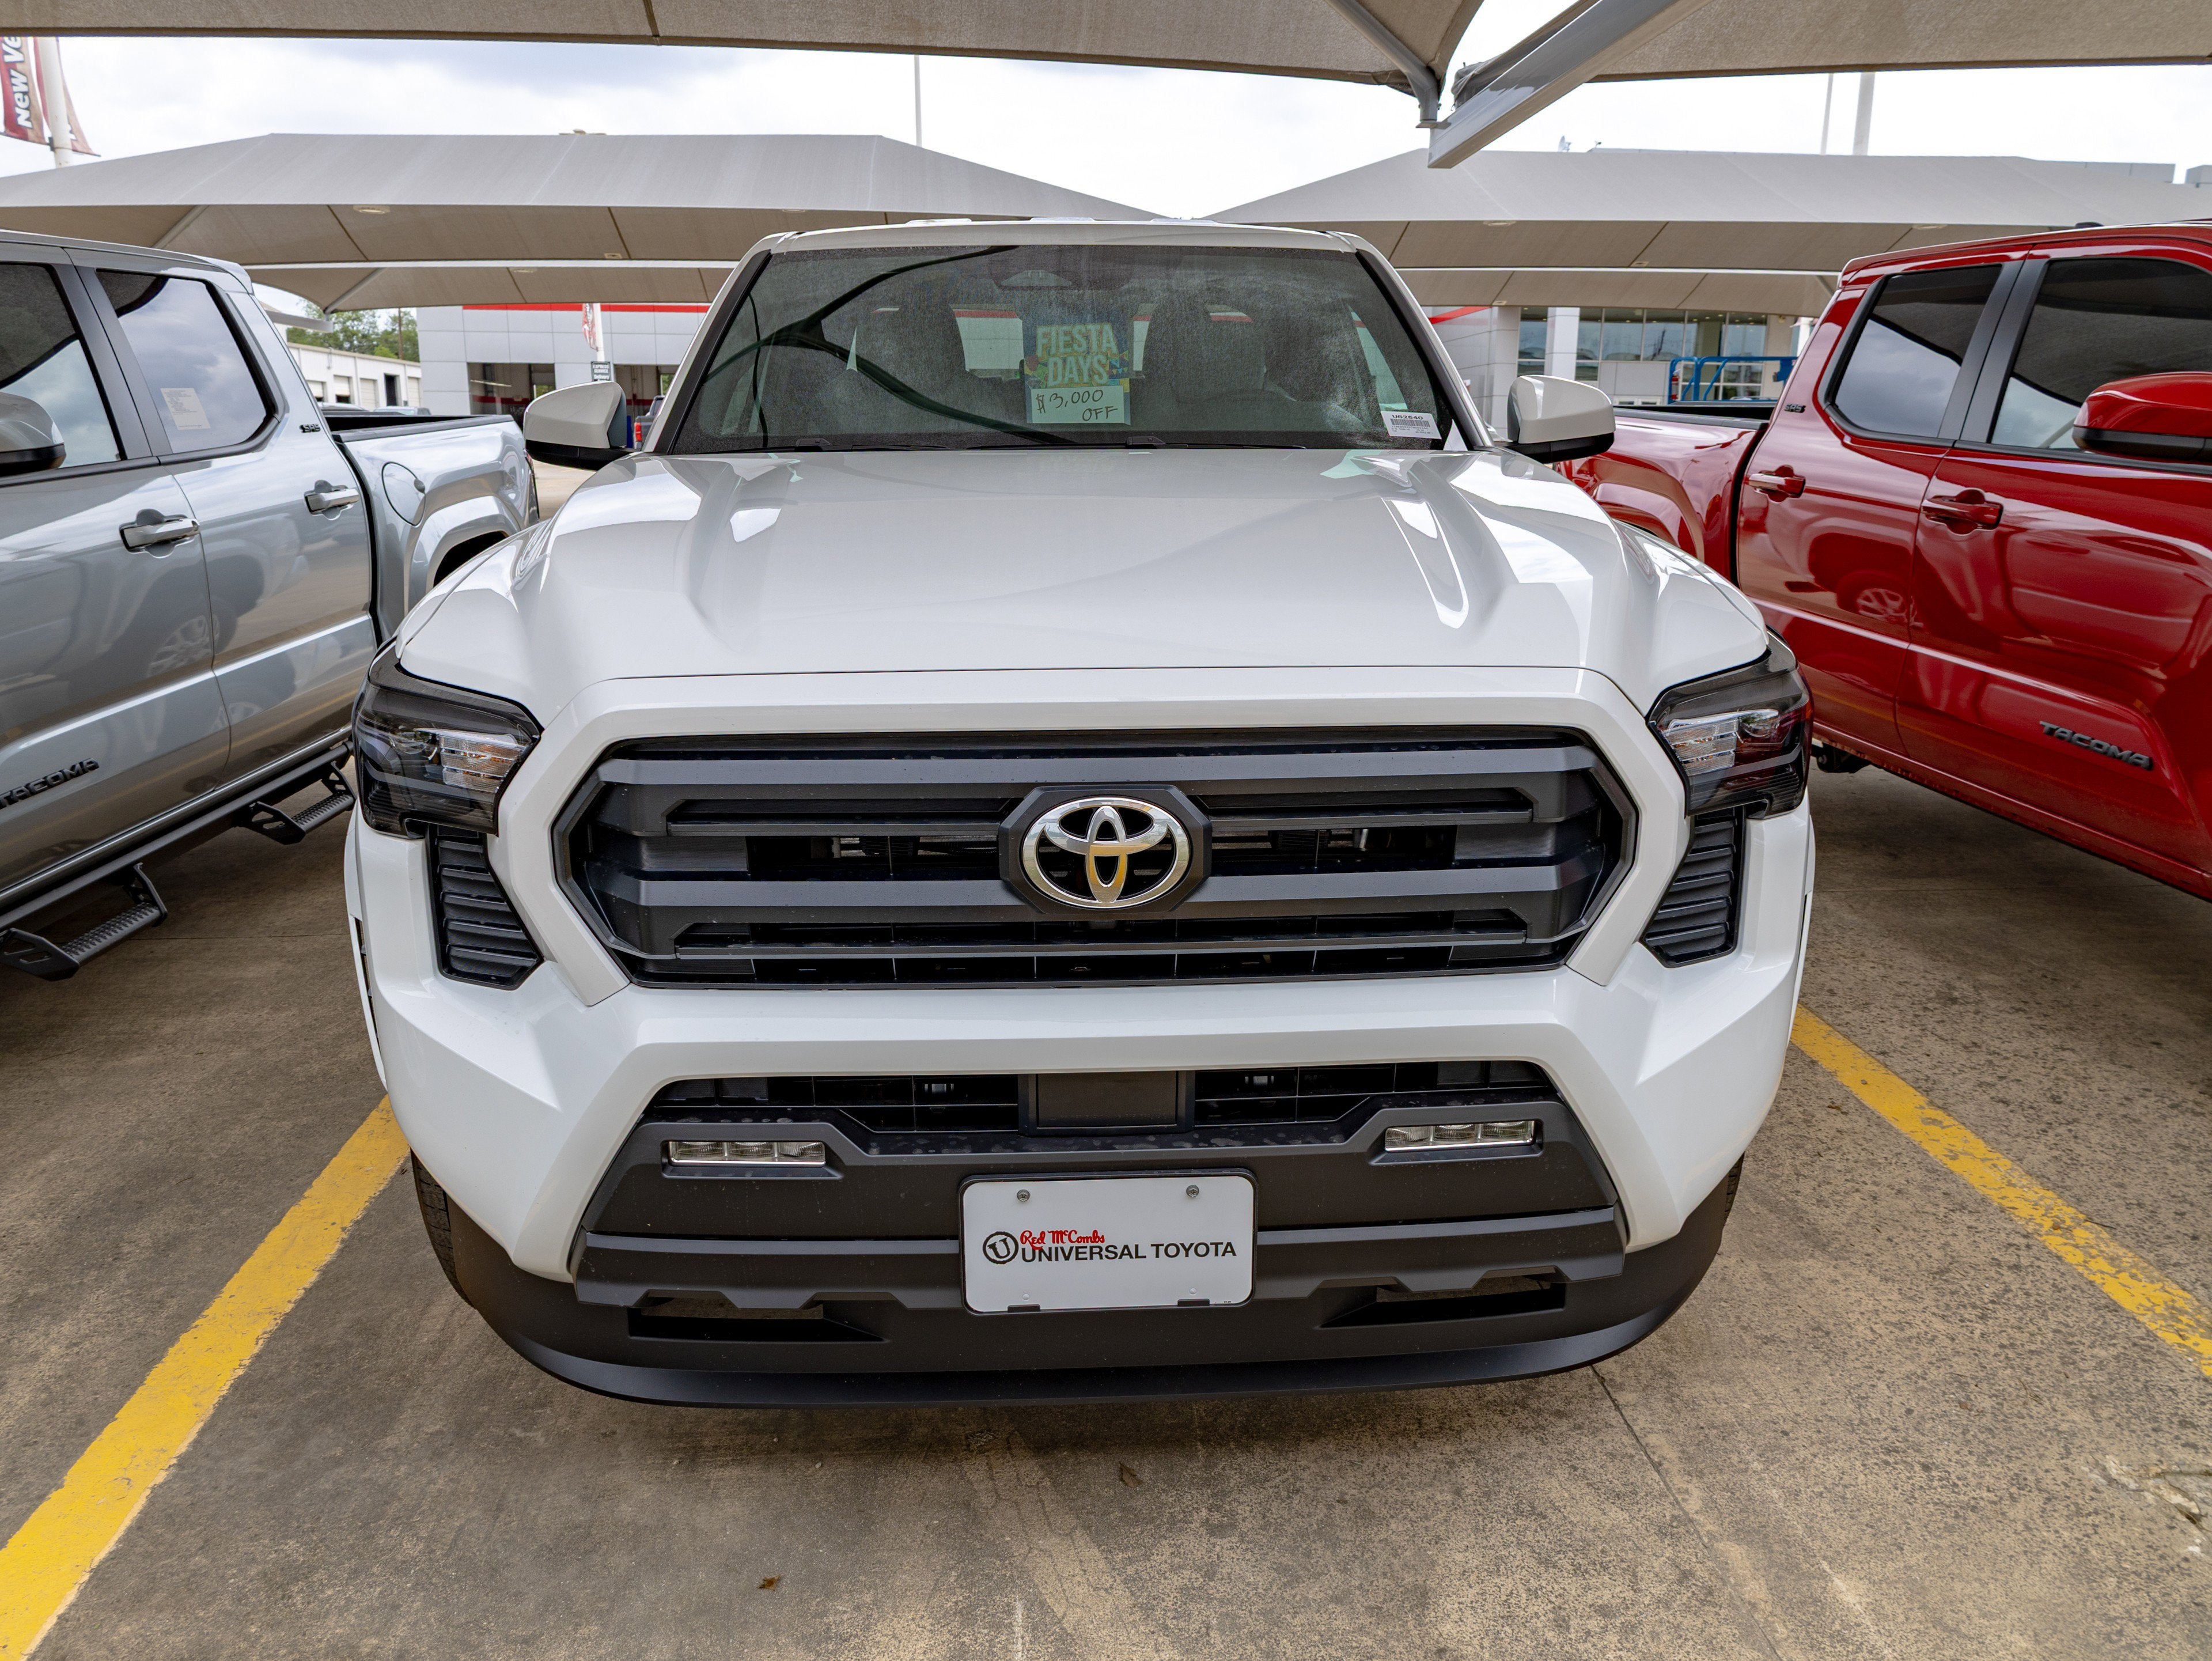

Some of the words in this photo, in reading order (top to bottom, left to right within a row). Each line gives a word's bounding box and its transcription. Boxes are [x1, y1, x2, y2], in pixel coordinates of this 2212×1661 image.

[10, 68, 33, 129] New
[1037, 323, 1119, 358] FIESTA
[1047, 354, 1109, 386] DAYS
[1082, 406, 1118, 422] OFF
[2039, 720, 2154, 771] TACOMA
[1020, 1230, 1046, 1250] Red
[1047, 1229, 1105, 1244] McCombs
[1021, 1244, 1147, 1263] UNIVERSAL
[1150, 1242, 1237, 1259] TOYOTA
